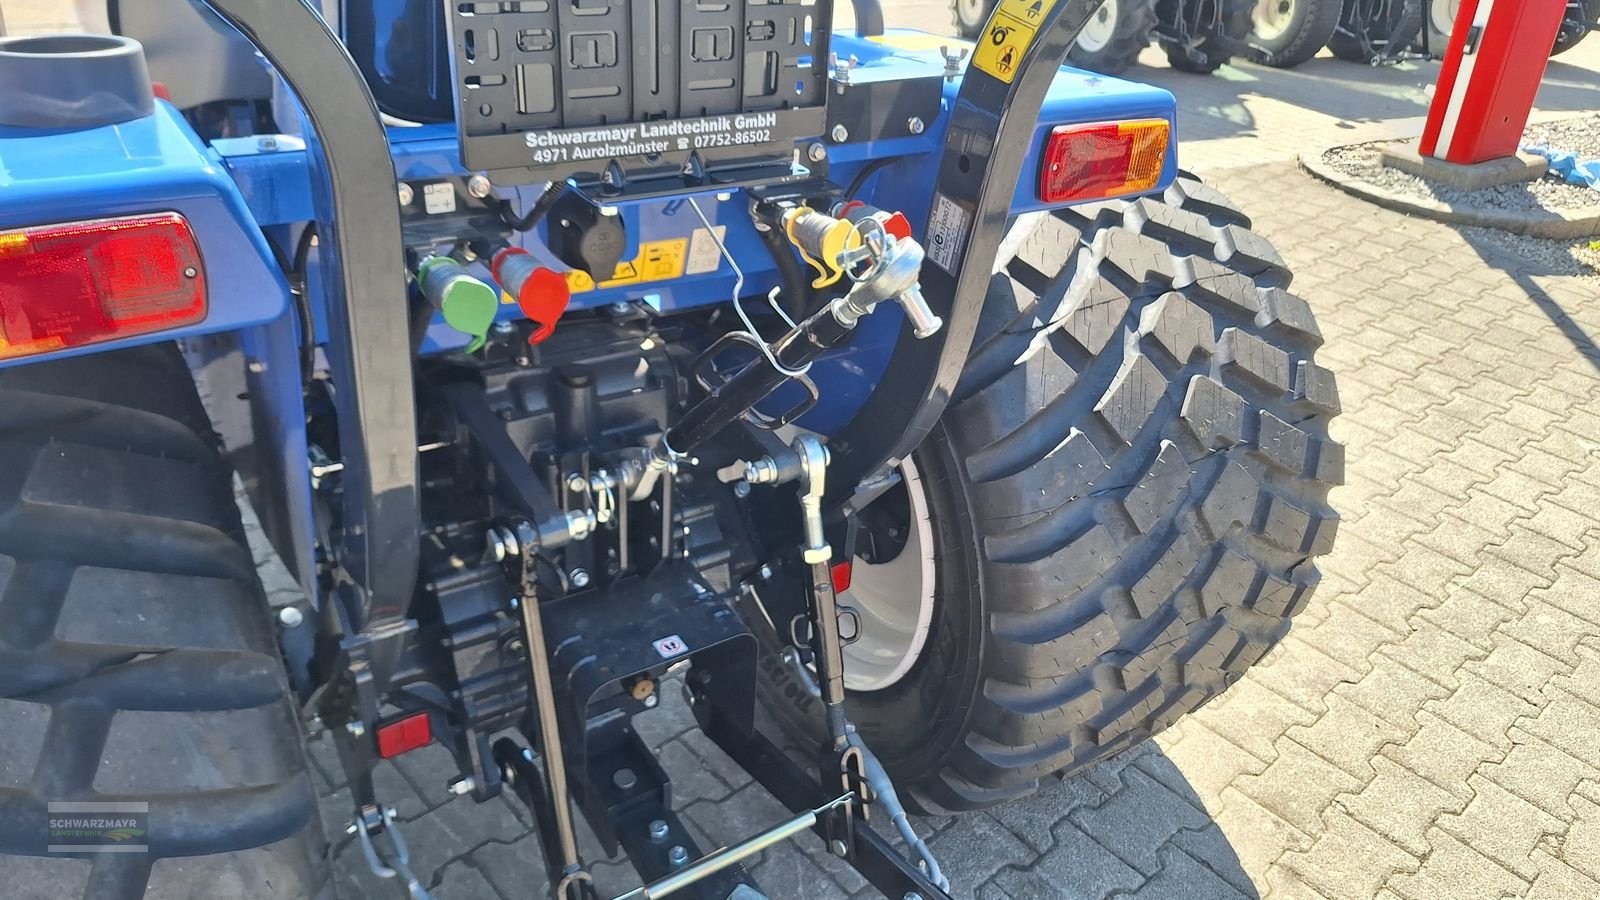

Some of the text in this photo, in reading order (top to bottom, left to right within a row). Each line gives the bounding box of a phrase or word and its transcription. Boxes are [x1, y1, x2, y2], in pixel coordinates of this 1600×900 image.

[525, 112, 776, 148] Schwarzmayr Landtechnik GmbH
[533, 129, 770, 163] 4971 Aurolzmünster 07752-86502
